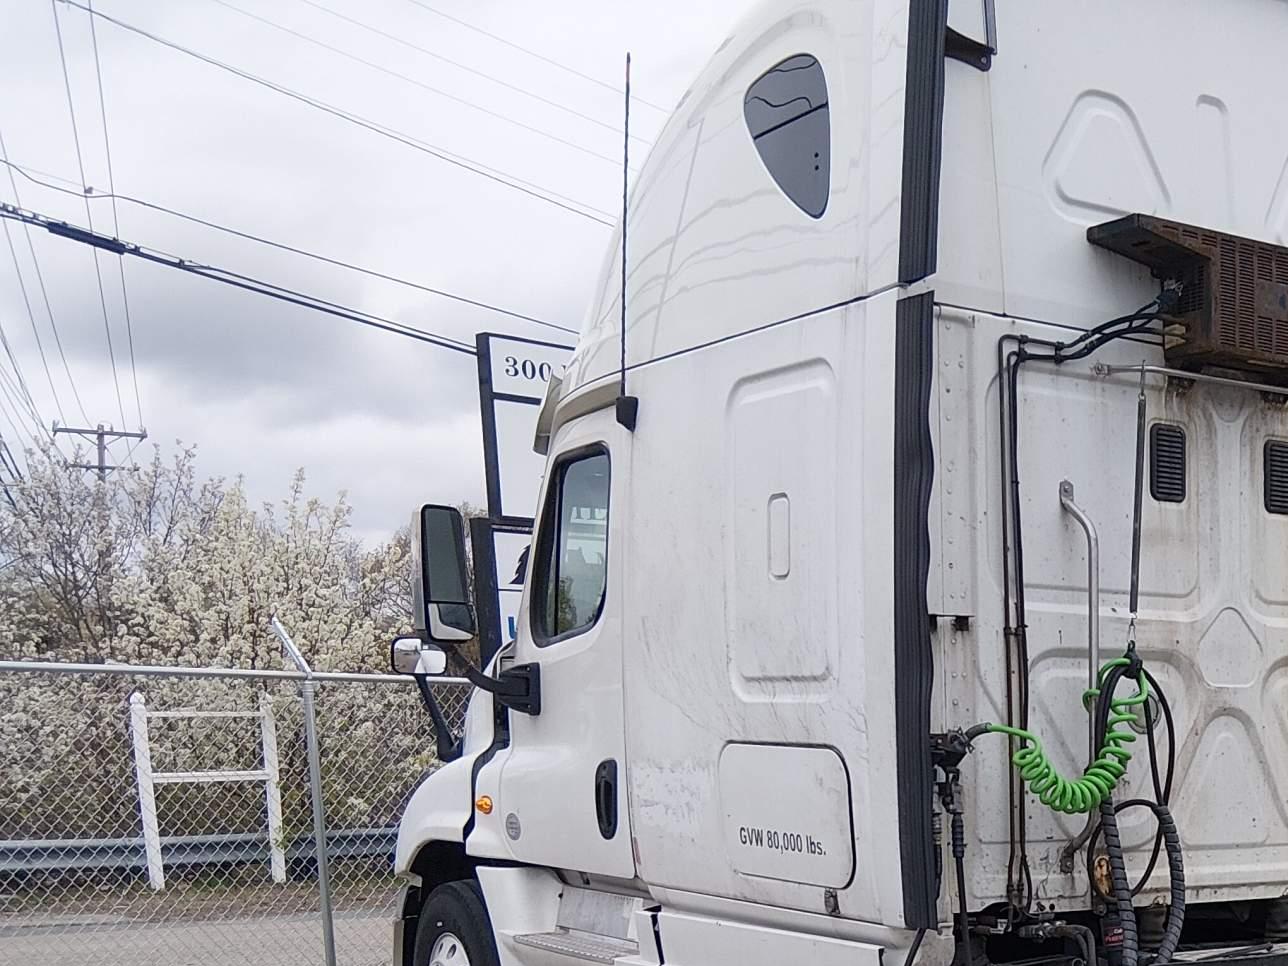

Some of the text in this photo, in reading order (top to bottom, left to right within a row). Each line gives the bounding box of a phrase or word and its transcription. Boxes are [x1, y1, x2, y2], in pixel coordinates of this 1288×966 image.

[505, 356, 552, 383] 300
[739, 827, 827, 856] GVW 80,000 lbs.
